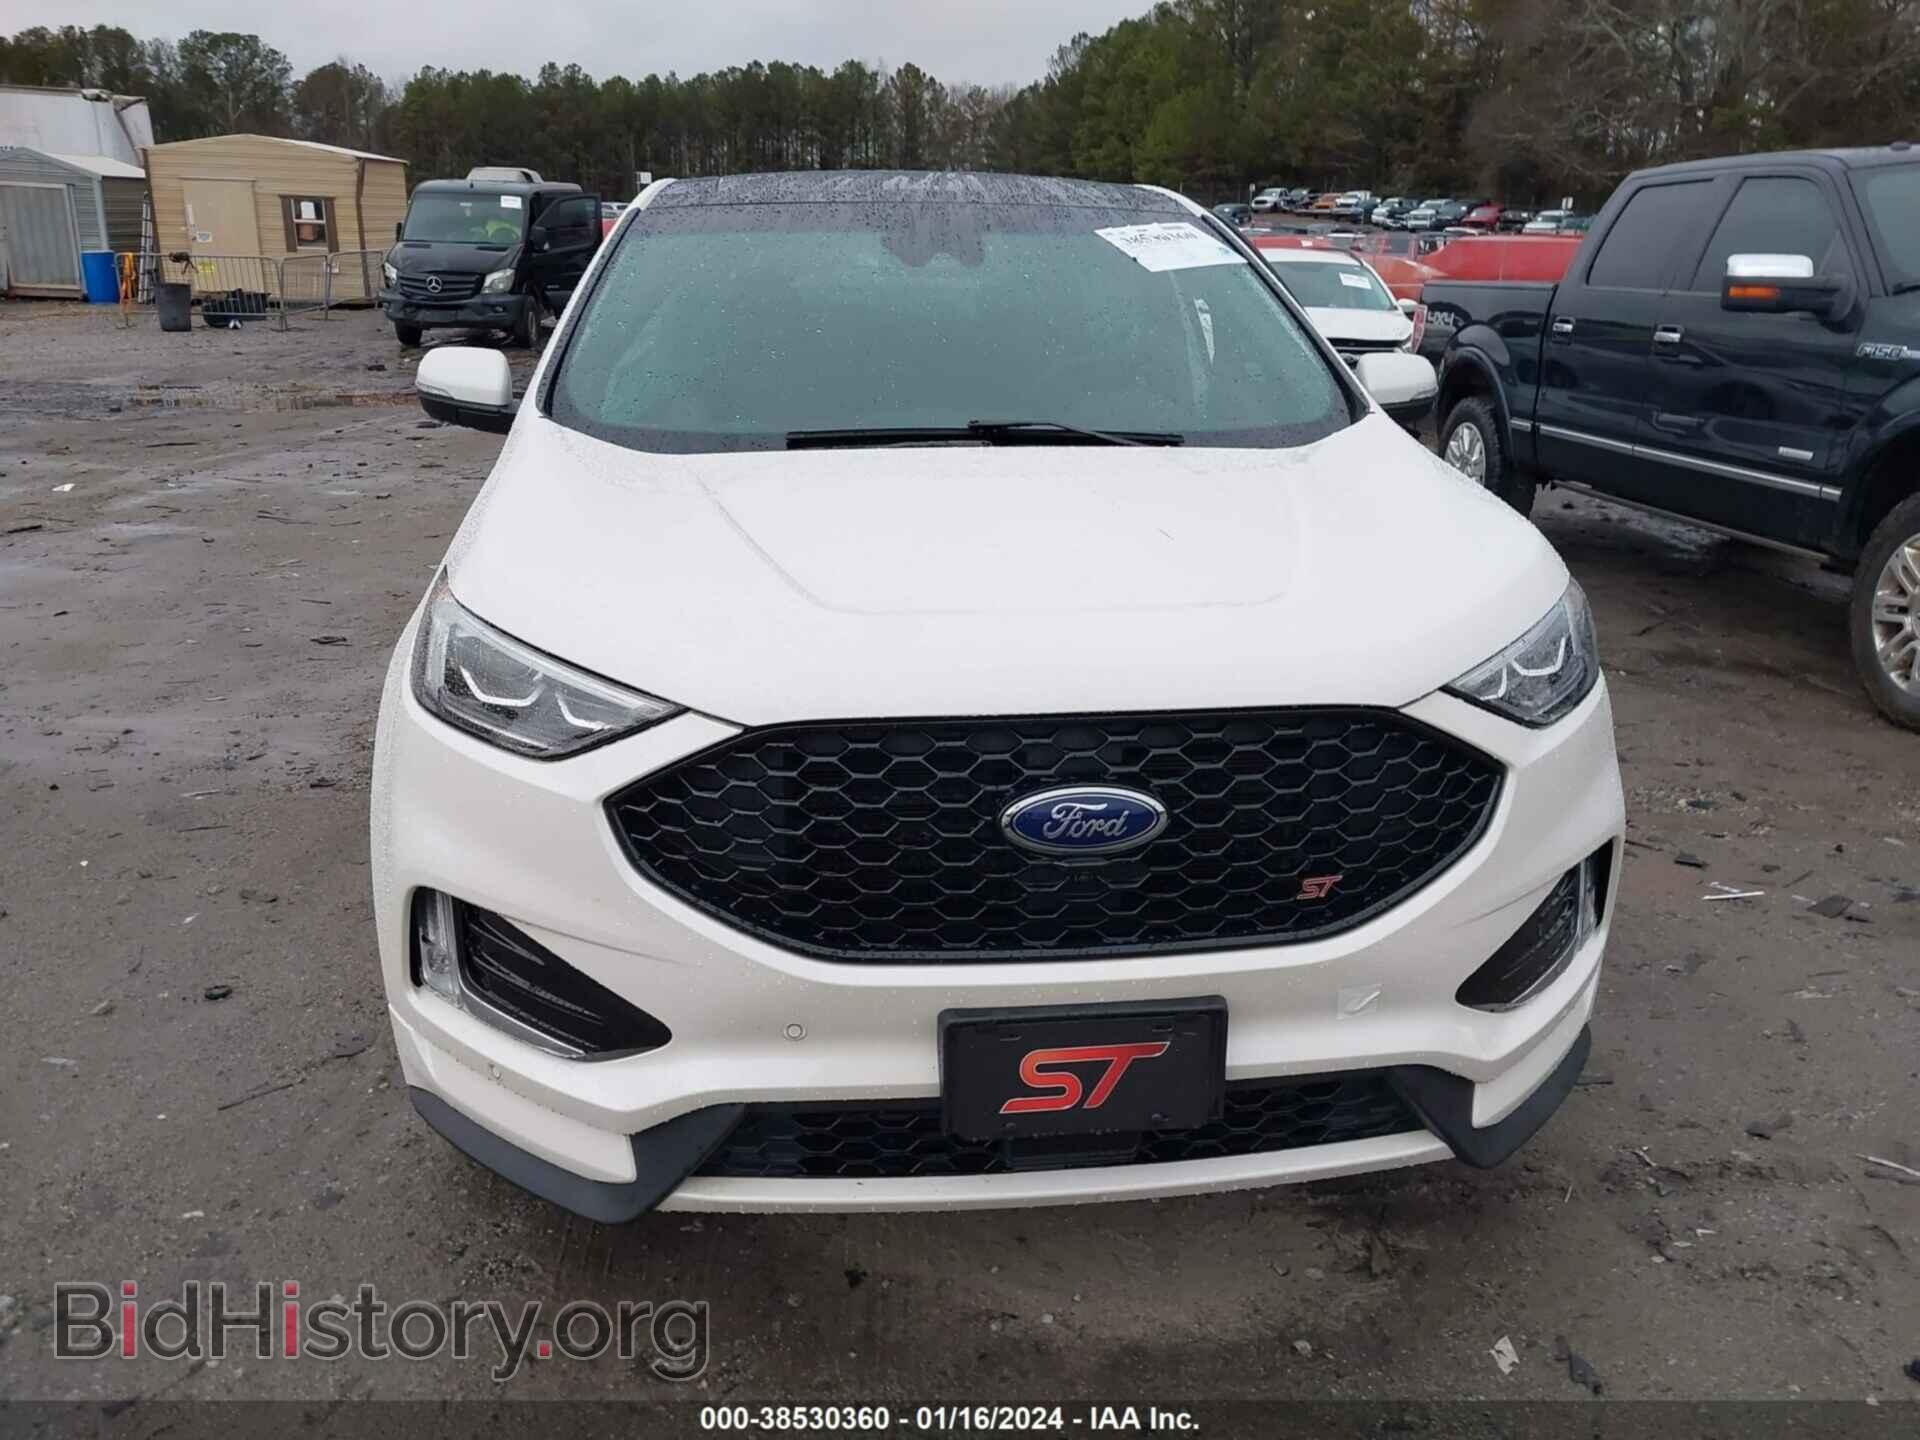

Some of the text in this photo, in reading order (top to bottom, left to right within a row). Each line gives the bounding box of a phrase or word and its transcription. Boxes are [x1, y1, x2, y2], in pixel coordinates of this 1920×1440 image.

[1043, 802, 1129, 839] Ford
[1297, 875, 1343, 899] ST
[1000, 1041, 1170, 1114] ST
